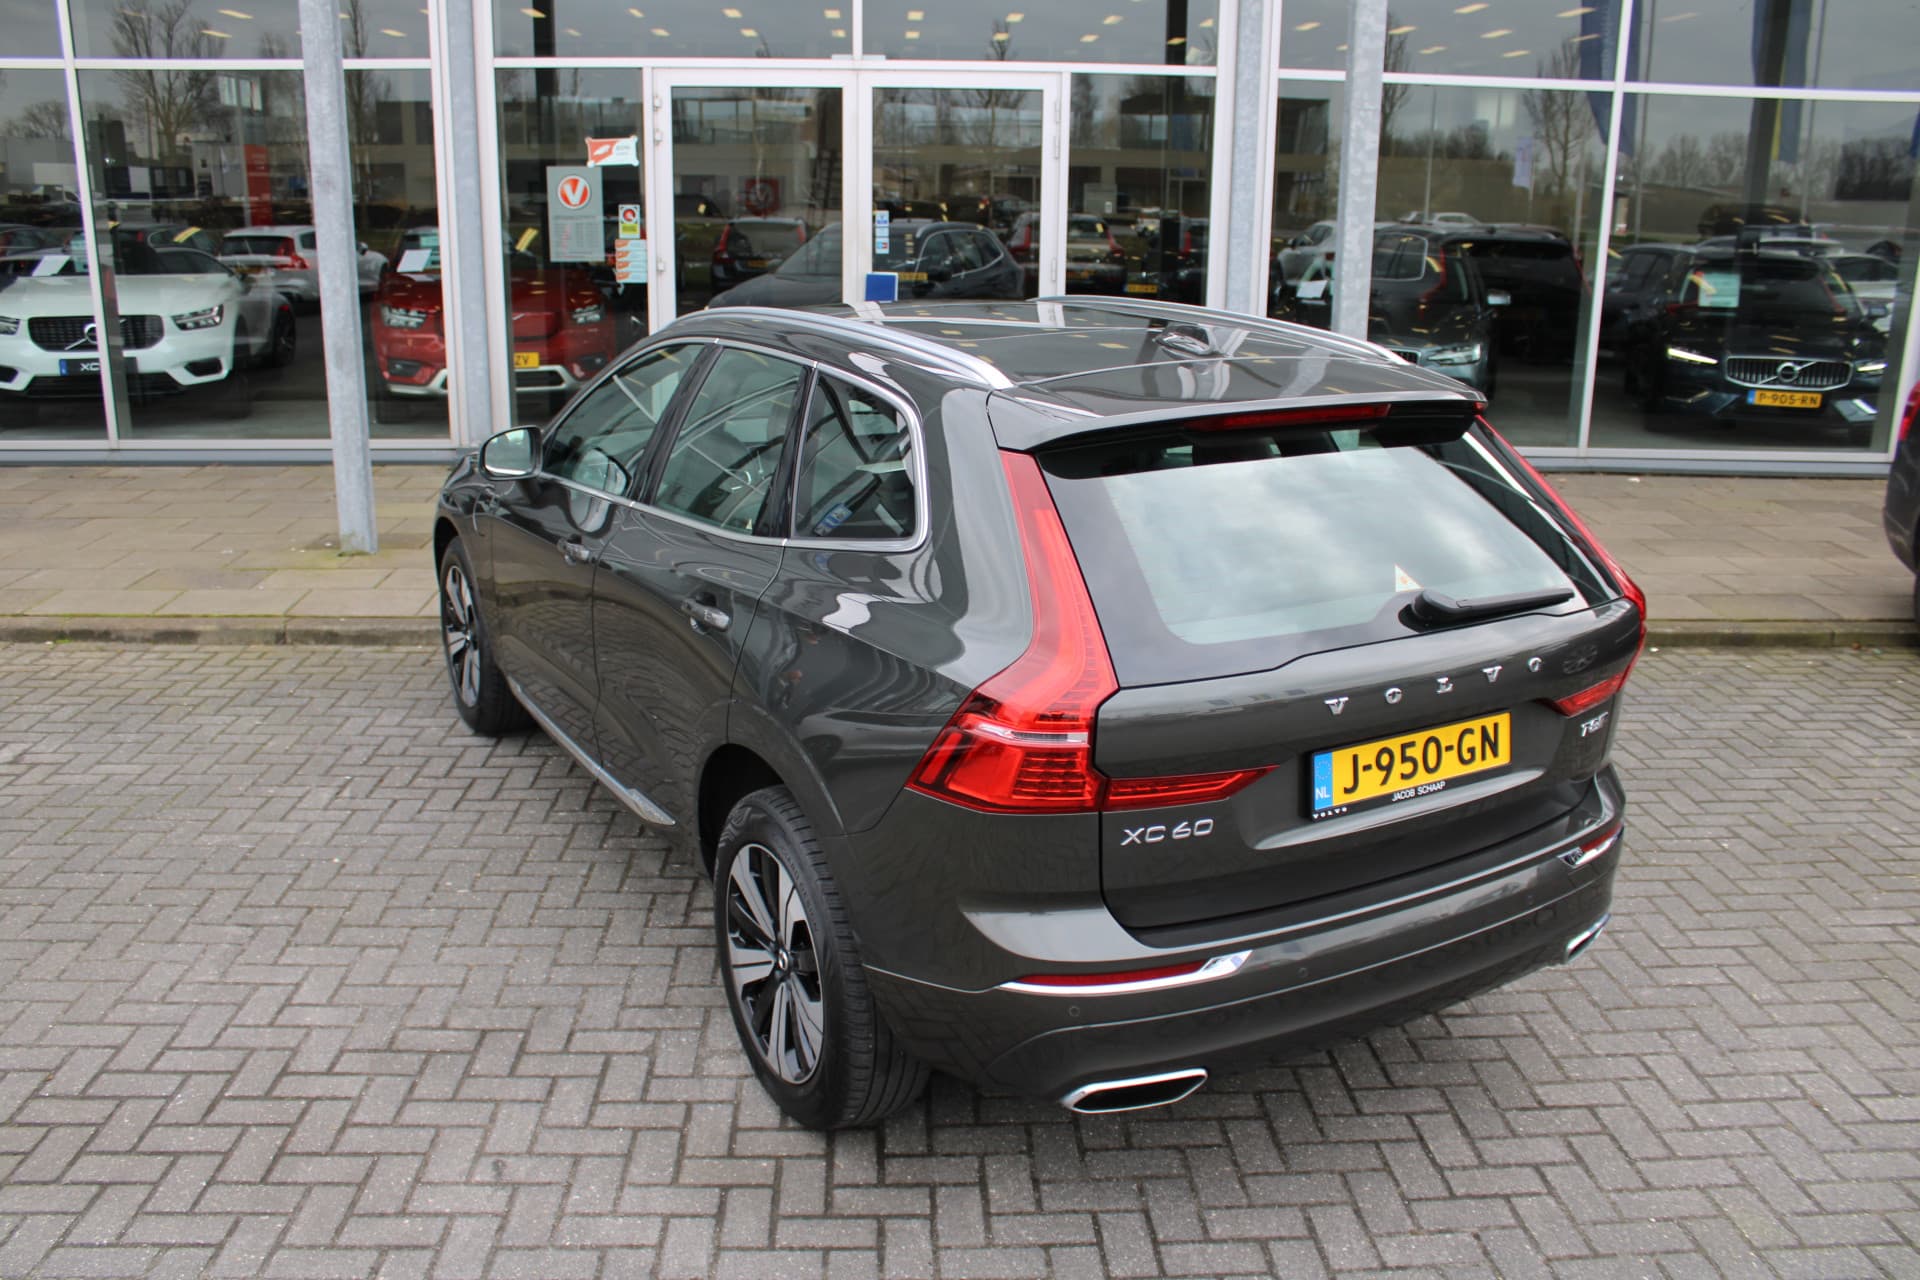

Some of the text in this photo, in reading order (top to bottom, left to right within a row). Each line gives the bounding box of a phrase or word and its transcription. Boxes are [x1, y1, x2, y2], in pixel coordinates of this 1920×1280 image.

[1324, 657, 1543, 715] VOLVO
[1343, 722, 1499, 794] J-950-GN
[1315, 786, 1330, 799] NL
[1392, 781, 1446, 801] JACOB SCHAAP
